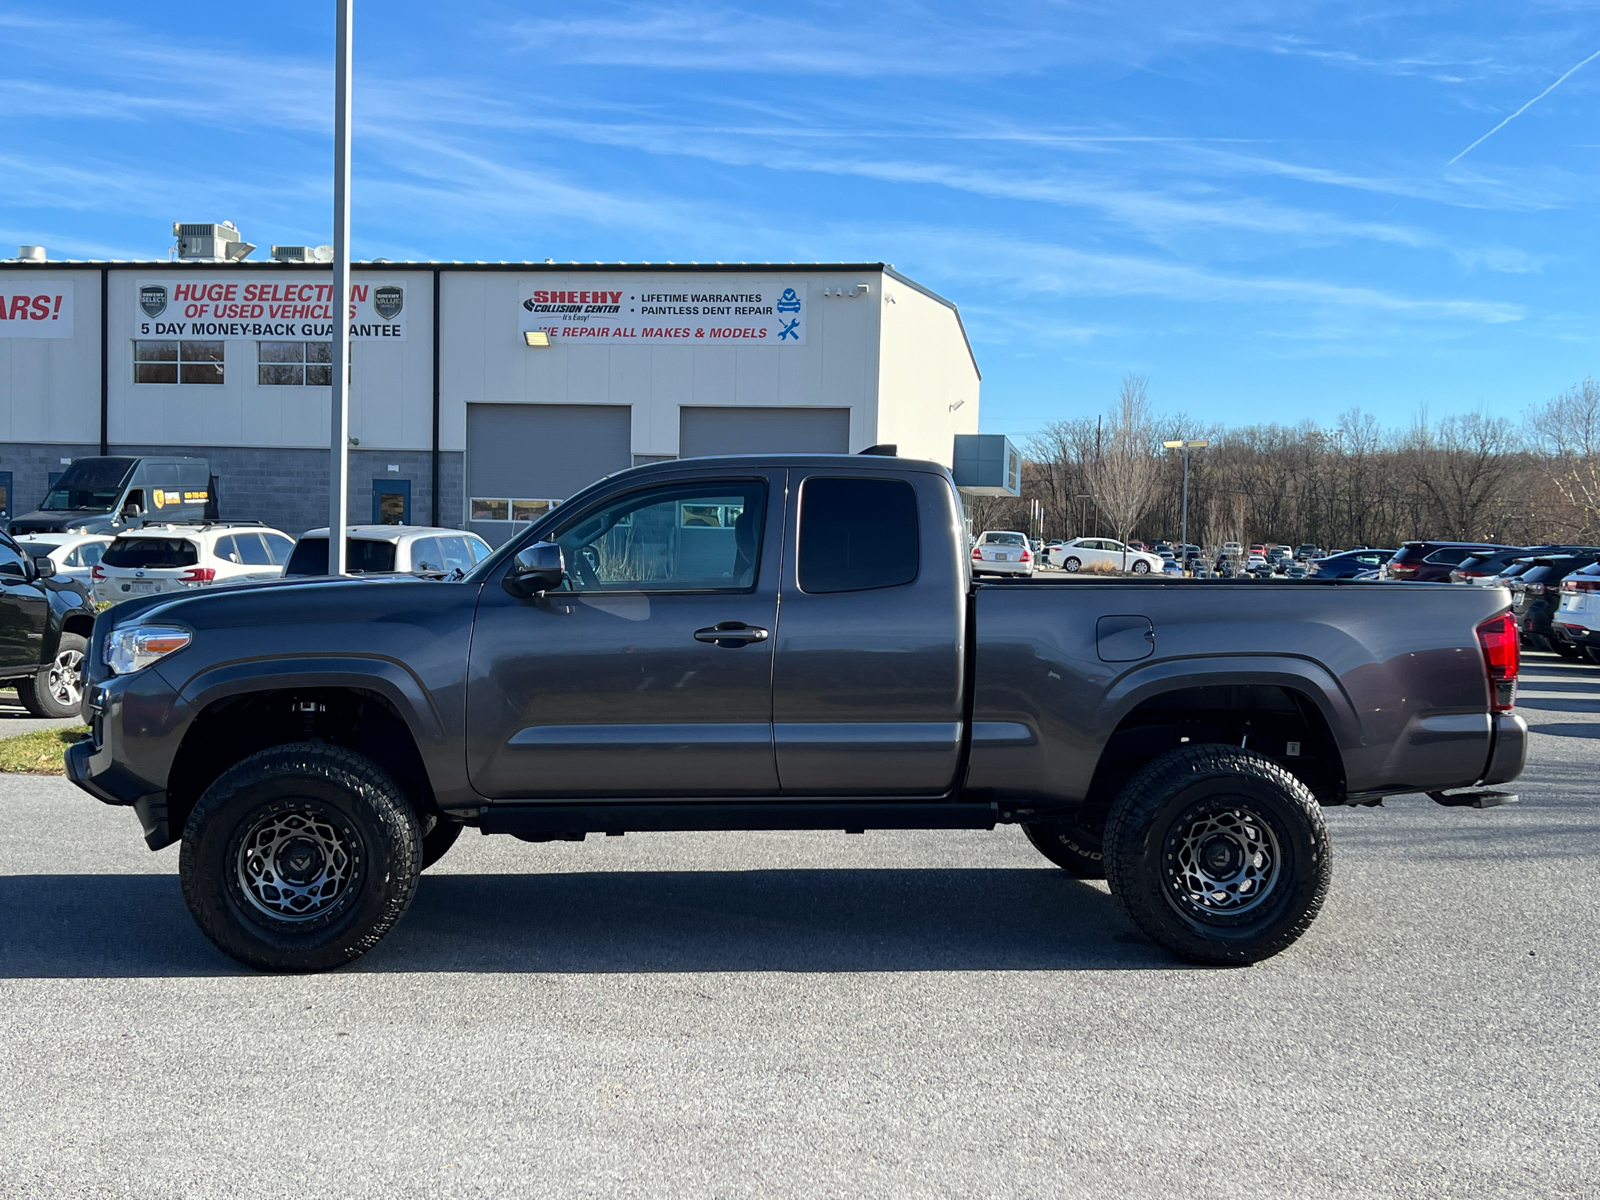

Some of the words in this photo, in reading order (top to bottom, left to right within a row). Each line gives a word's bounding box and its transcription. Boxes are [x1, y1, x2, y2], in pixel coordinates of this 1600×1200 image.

[174, 284, 238, 301] HUGE
[243, 284, 369, 302] SELECTIN
[533, 290, 623, 304] SHEEHY
[641, 294, 688, 302] LIFETIME
[691, 294, 762, 303] WARRANTIES
[184, 304, 210, 318] OF
[213, 304, 264, 319] USED
[269, 304, 357, 319] VEHICLS
[534, 304, 583, 313] COLLISION
[584, 305, 621, 313] CENTER
[641, 306, 699, 315] PAINTLESS
[702, 306, 732, 315] DENT
[734, 307, 773, 315] REPAIR
[573, 314, 590, 322] Easy!
[141, 323, 150, 334] 5
[155, 323, 187, 335] DAY
[192, 323, 296, 336] MONEY-BACK
[301, 324, 402, 337] GUAANTEE
[562, 327, 610, 337] REPAIR
[612, 327, 638, 338] ALL
[641, 327, 691, 338] MAKES
[694, 328, 706, 338] &
[709, 327, 768, 338] MODELS
